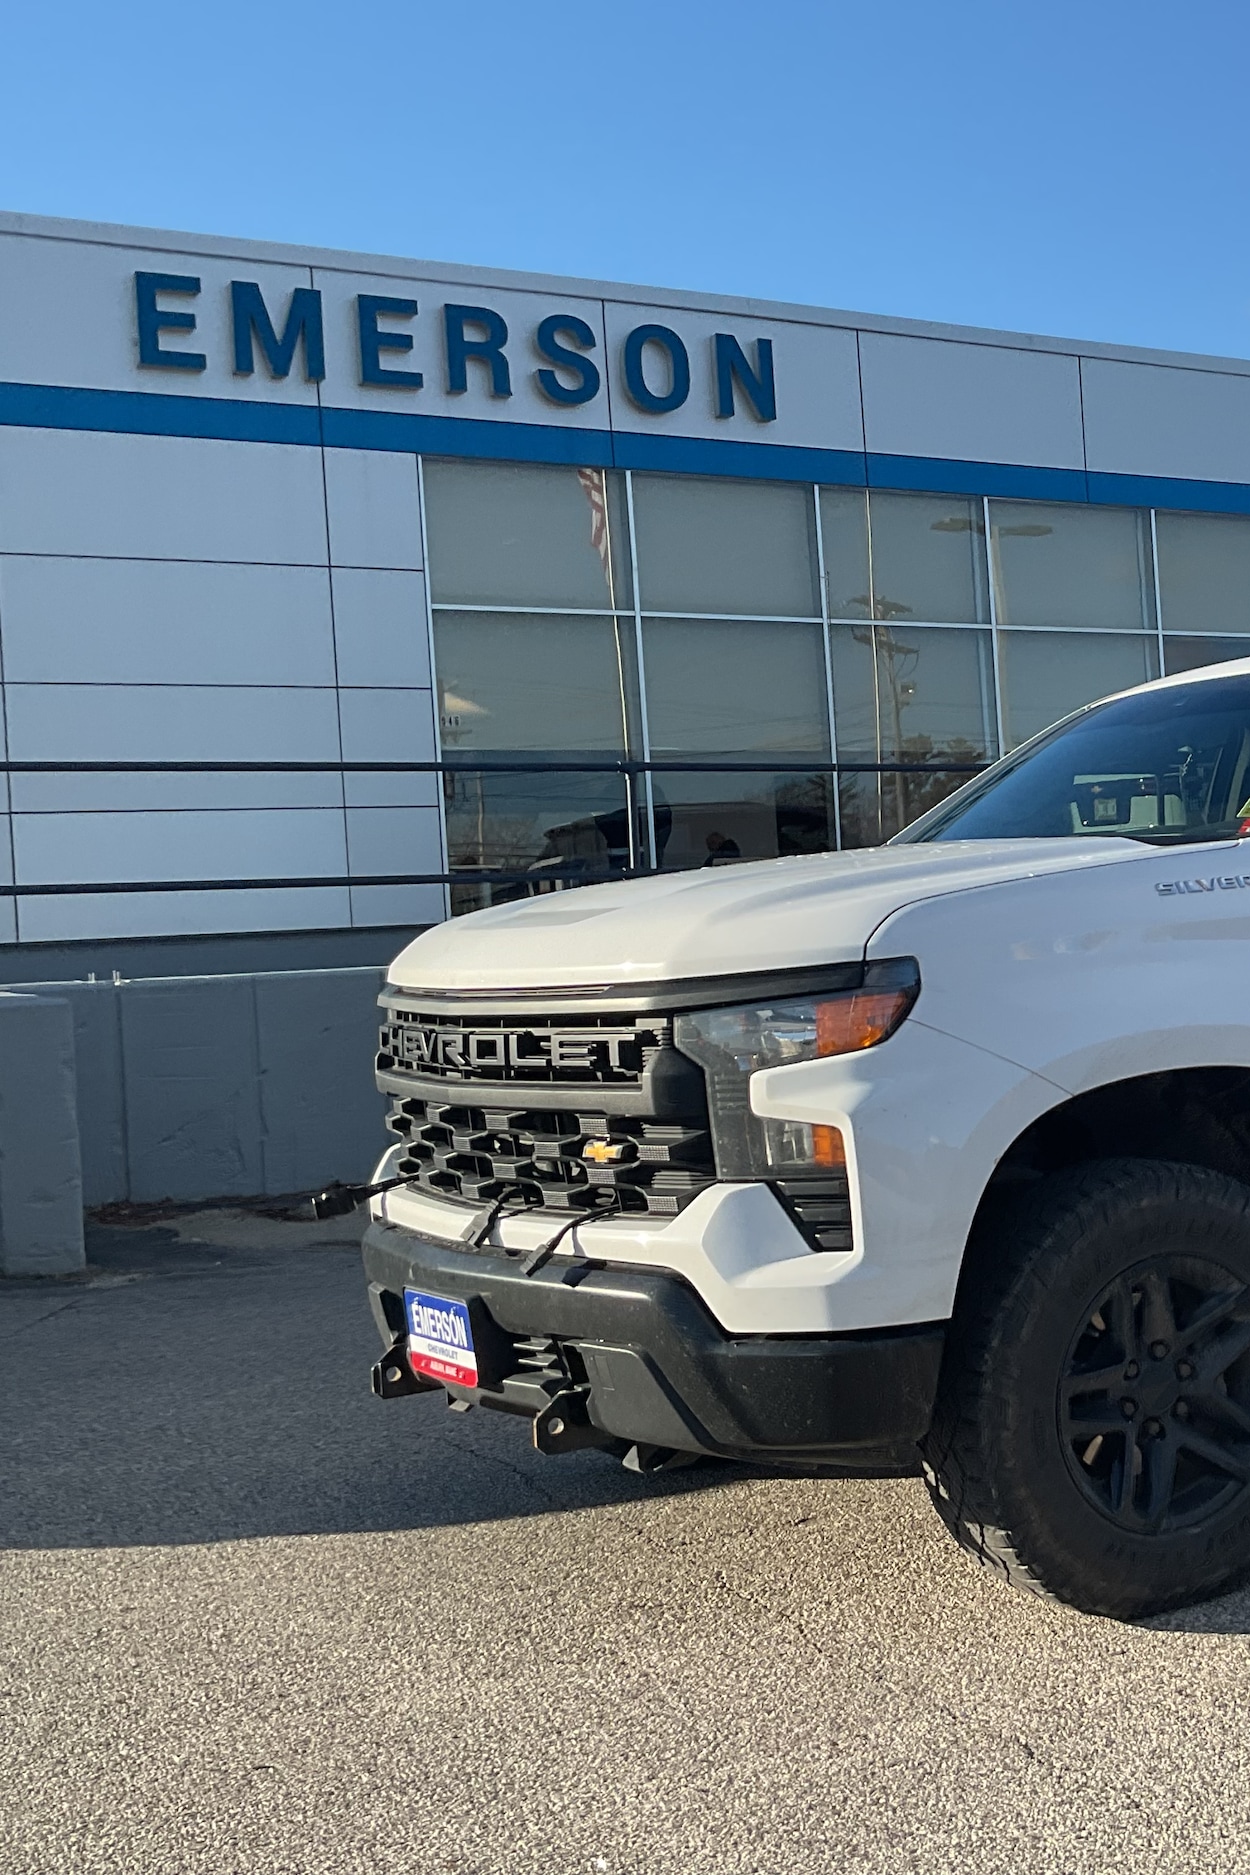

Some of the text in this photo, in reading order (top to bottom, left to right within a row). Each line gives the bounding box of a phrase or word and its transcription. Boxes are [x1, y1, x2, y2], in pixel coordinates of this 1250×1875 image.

[134, 271, 777, 424] EMERSON
[379, 1025, 636, 1067] CHEVROLET
[411, 1303, 468, 1348] EMERSON
